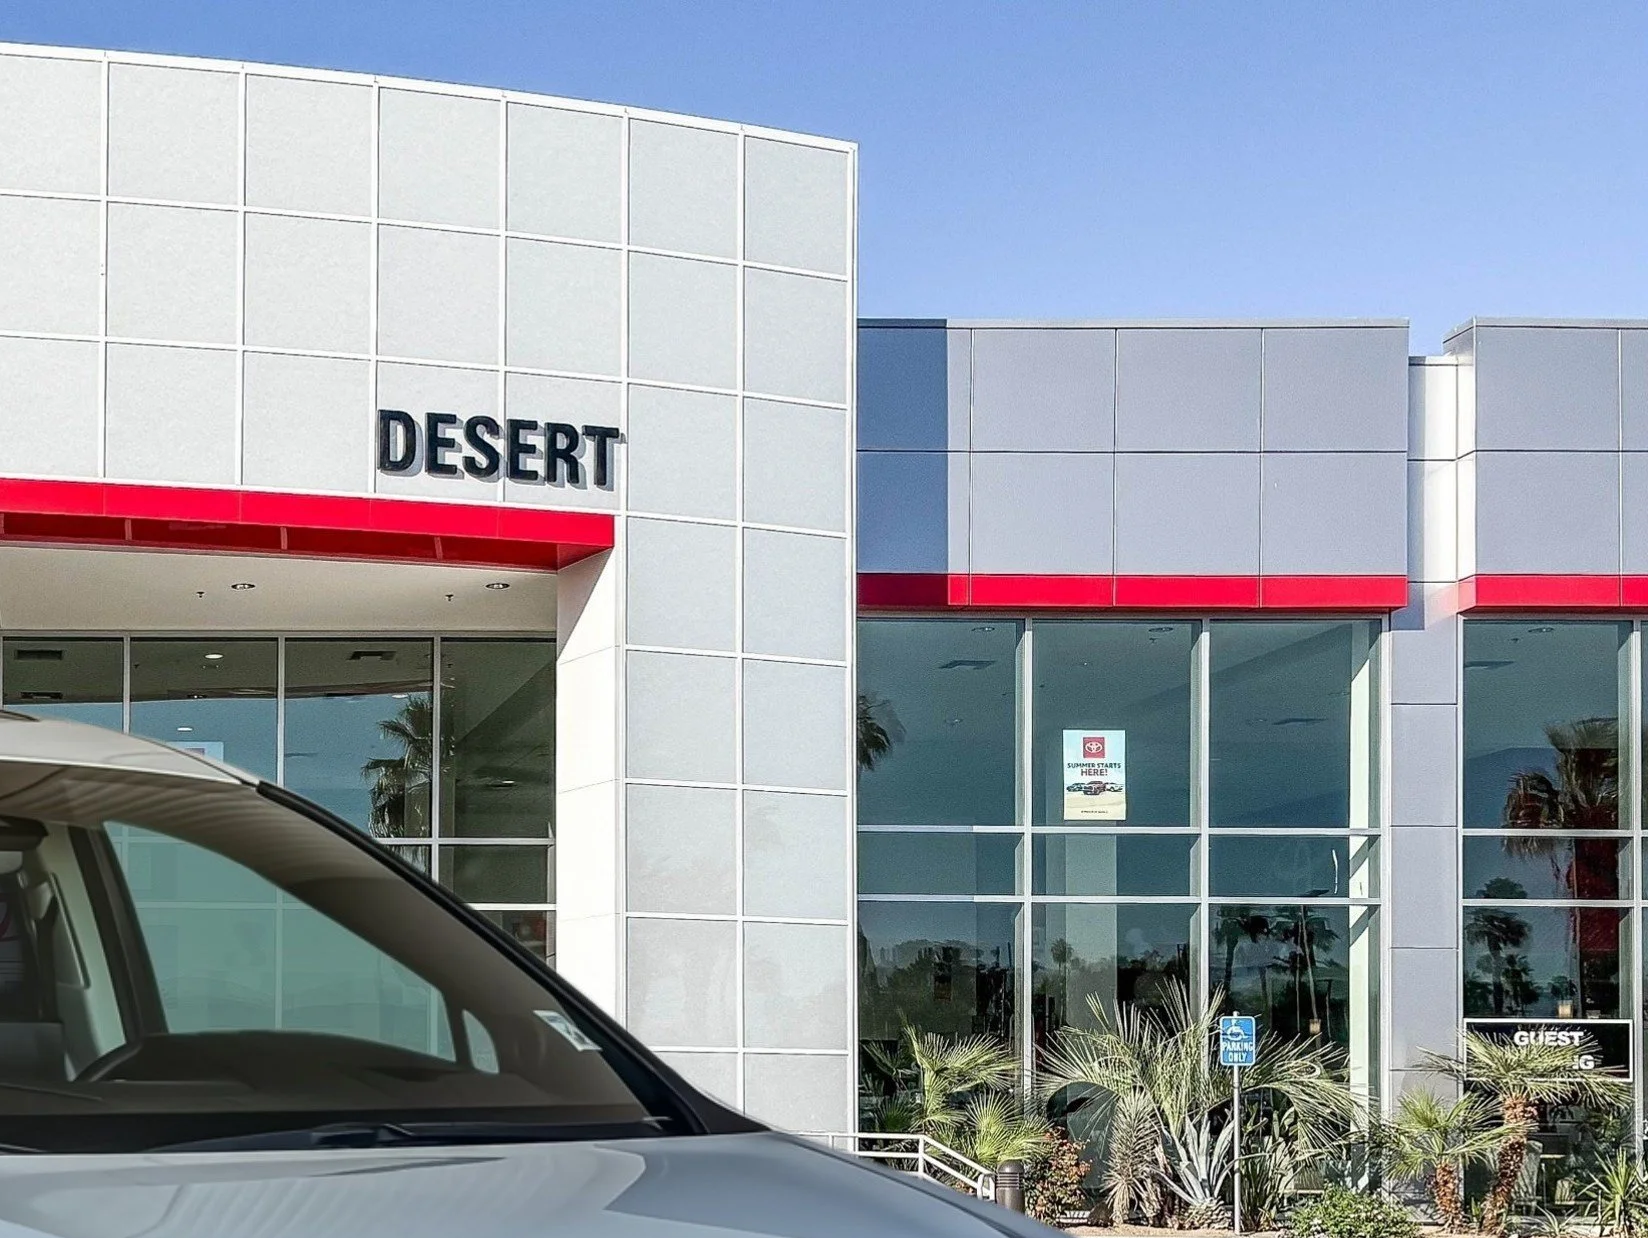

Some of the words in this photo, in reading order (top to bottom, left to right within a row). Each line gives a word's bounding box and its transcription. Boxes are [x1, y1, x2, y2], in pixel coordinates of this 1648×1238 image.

[377, 409, 620, 487] DESERT
[1080, 768, 1108, 777] HERE!
[1513, 1030, 1584, 1047] GUEST
[1222, 1041, 1254, 1052] PARKING
[1228, 1052, 1248, 1062] ONLY
